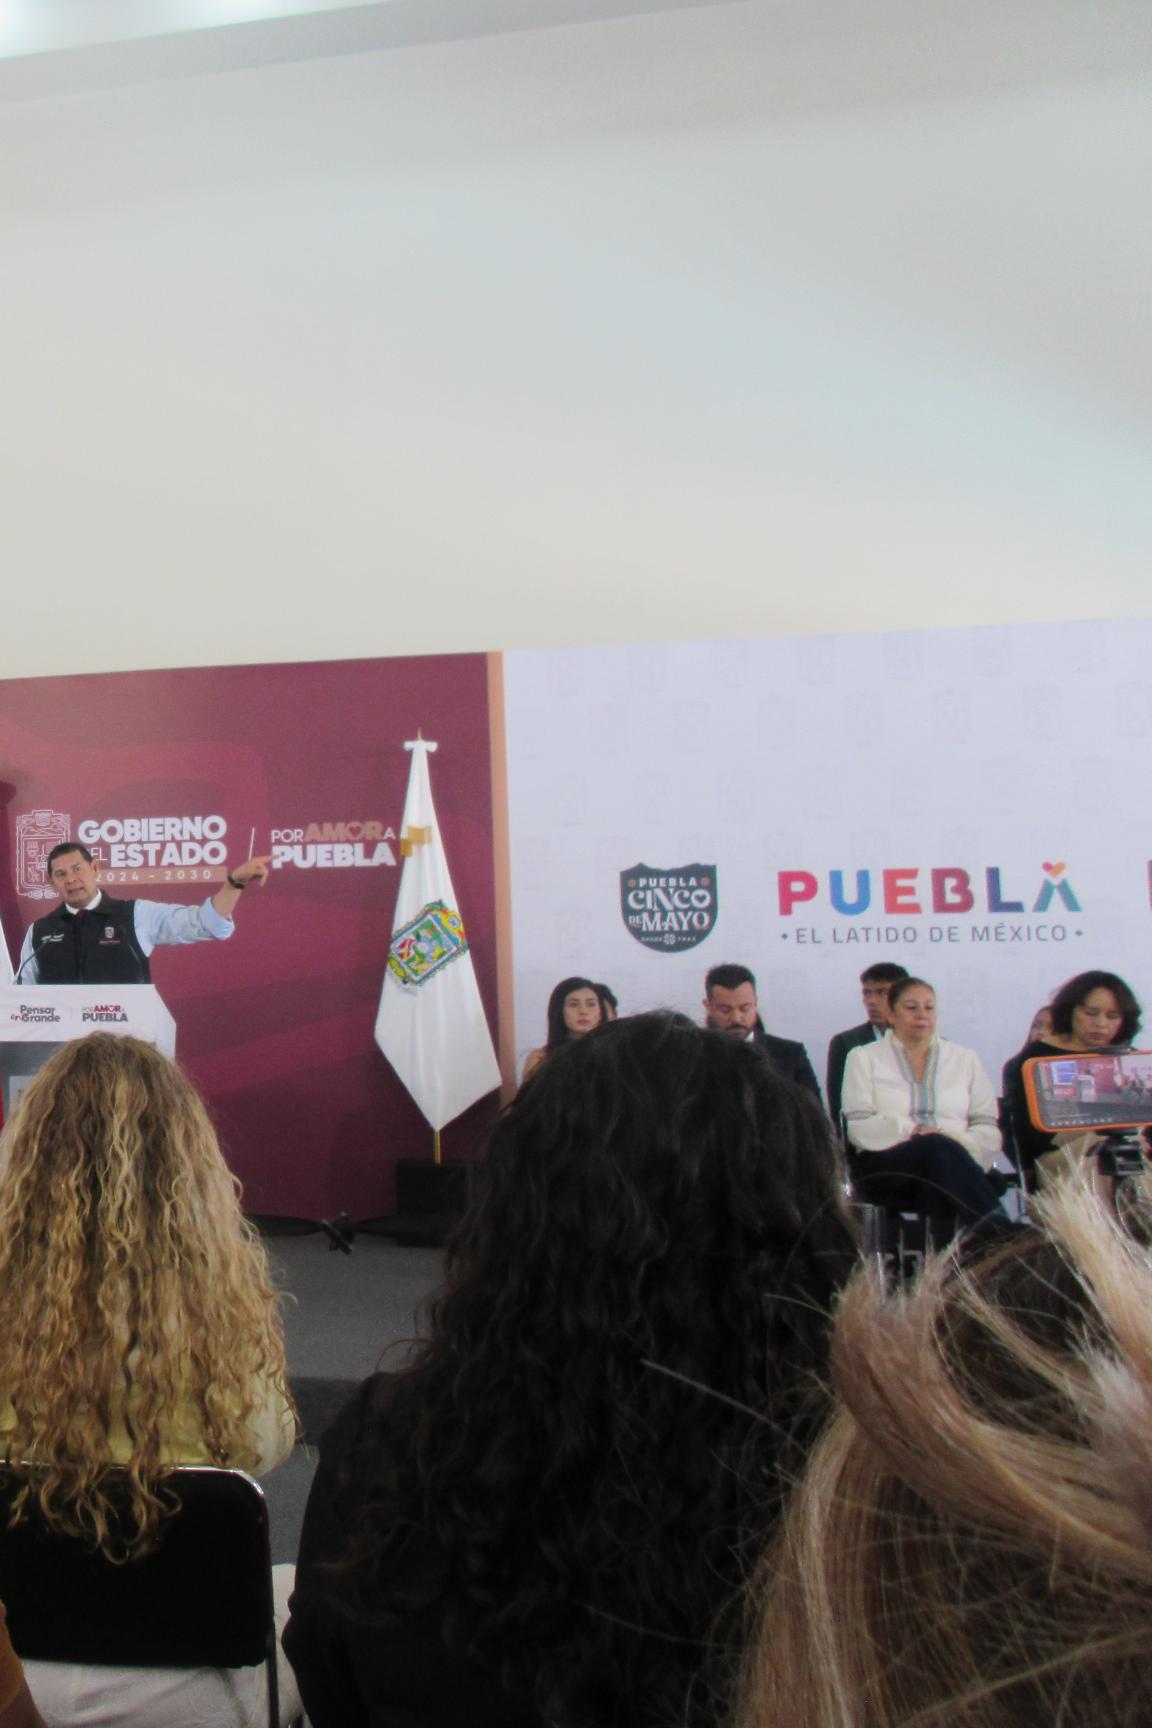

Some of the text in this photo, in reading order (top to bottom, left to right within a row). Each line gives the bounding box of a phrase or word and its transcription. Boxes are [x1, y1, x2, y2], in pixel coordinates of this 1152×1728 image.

[77, 815, 228, 844] GOBIERNO
[271, 821, 396, 843] POR AMOR A
[110, 841, 228, 868] ESTADO
[272, 842, 397, 869] PUEBLA
[164, 869, 211, 881] 2030
[639, 877, 697, 888] PUEBLA
[628, 888, 711, 911] CINCO
[778, 861, 1083, 916] PUEBLA
[628, 911, 710, 931] DE MAYO
[796, 922, 1066, 944] EL LATIDO DE MÉXICO
[20, 1005, 56, 1015] Pensar
[21, 1014, 61, 1022] Grande
[82, 1012, 129, 1023] PUEBLA
